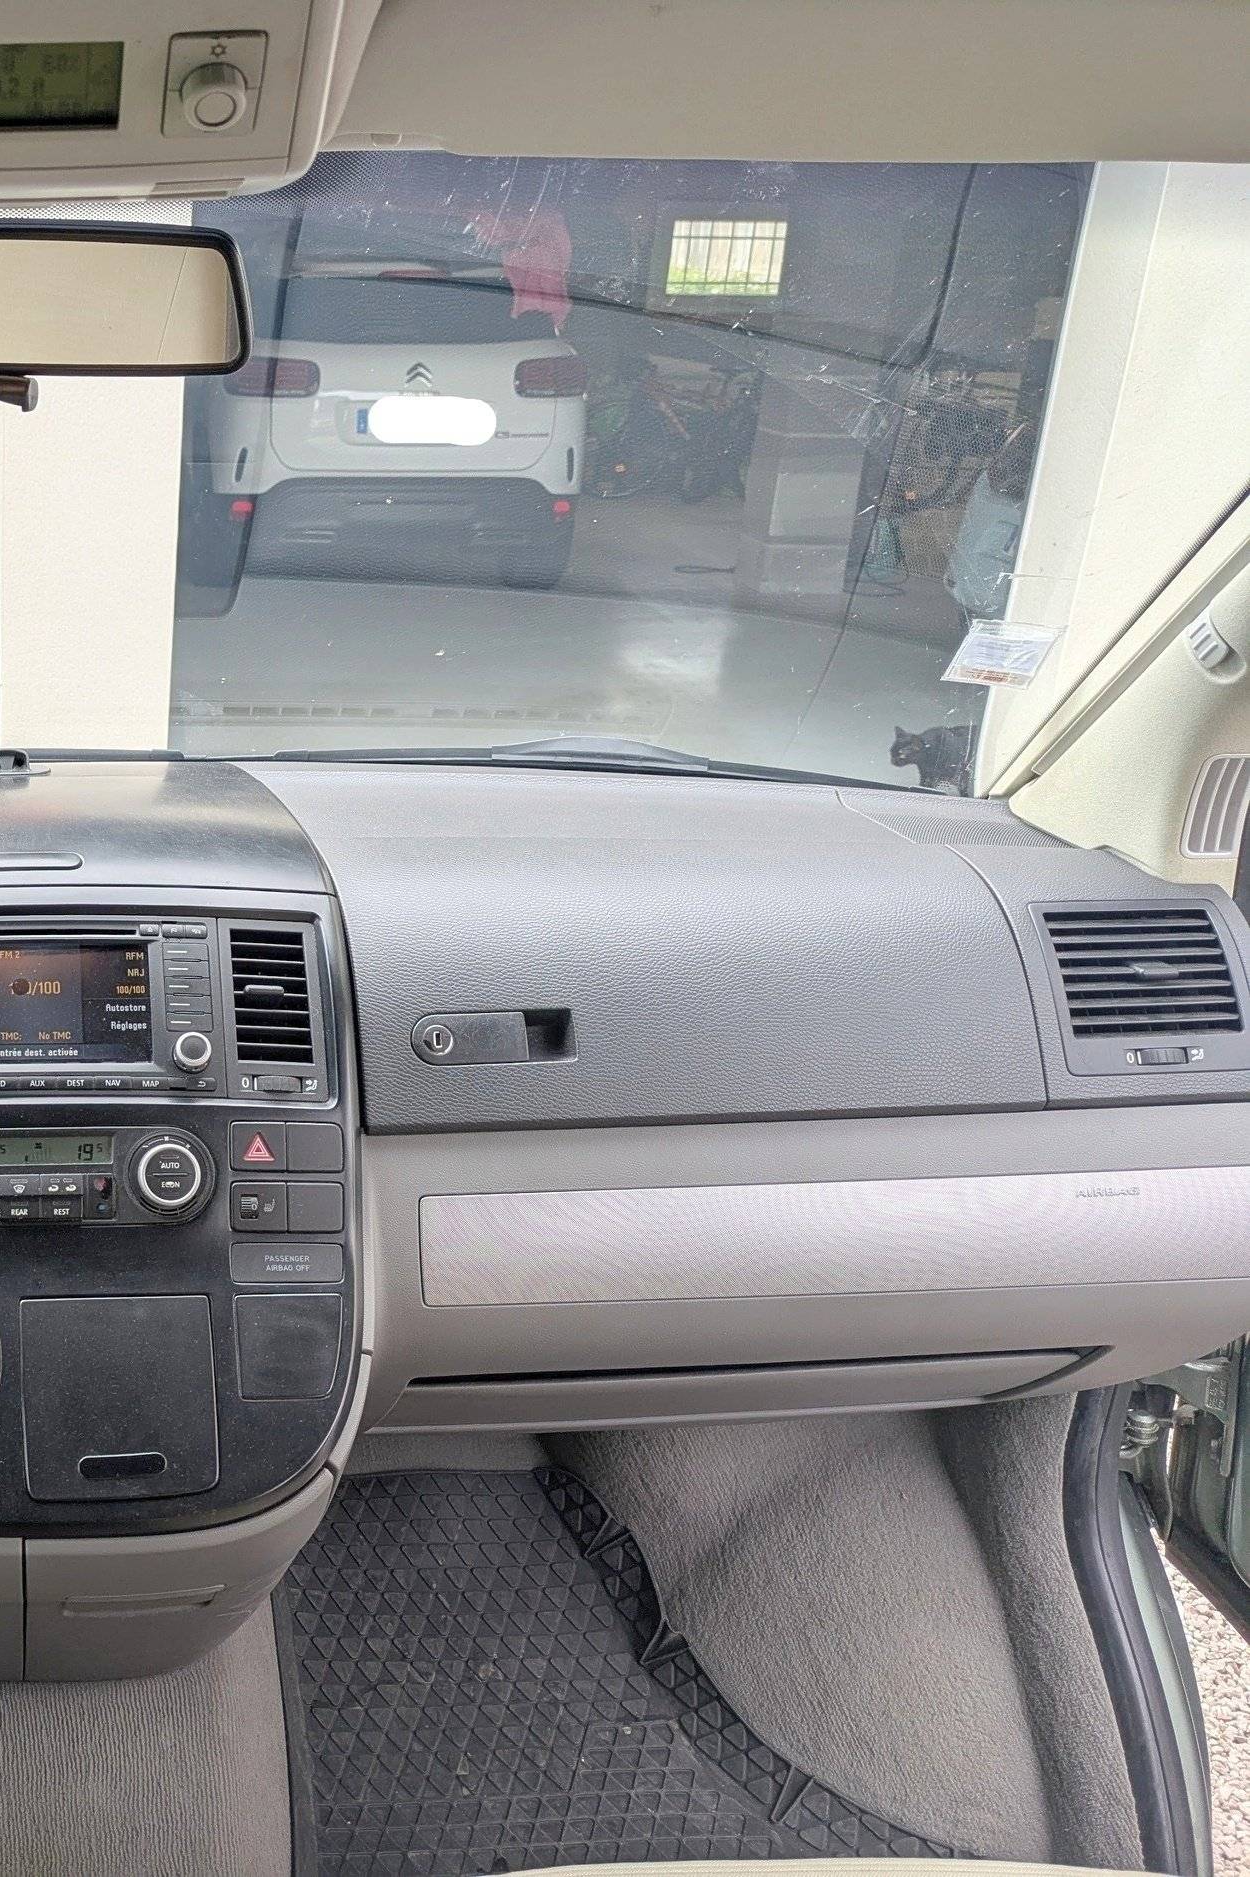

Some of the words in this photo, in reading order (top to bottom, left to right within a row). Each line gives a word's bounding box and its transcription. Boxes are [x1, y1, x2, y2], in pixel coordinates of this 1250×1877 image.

[0, 951, 12, 959] FM
[15, 951, 21, 959] 2
[125, 952, 144, 960] RFM
[127, 969, 145, 977] NRJ
[116, 985, 146, 995] 100/100
[105, 1004, 146, 1012] Autostore
[110, 1021, 147, 1031] Réglages
[38, 1032, 50, 1040] No
[53, 1031, 71, 1040] TMC
[48, 1047, 79, 1056] activée
[30, 1079, 46, 1087] AUX
[66, 1079, 85, 1087] DEST
[105, 1079, 121, 1087] NAV
[142, 1080, 160, 1088] MAP
[241, 1077, 250, 1089] 0
[10, 1208, 29, 1216] REAR
[53, 1208, 70, 1216] REST
